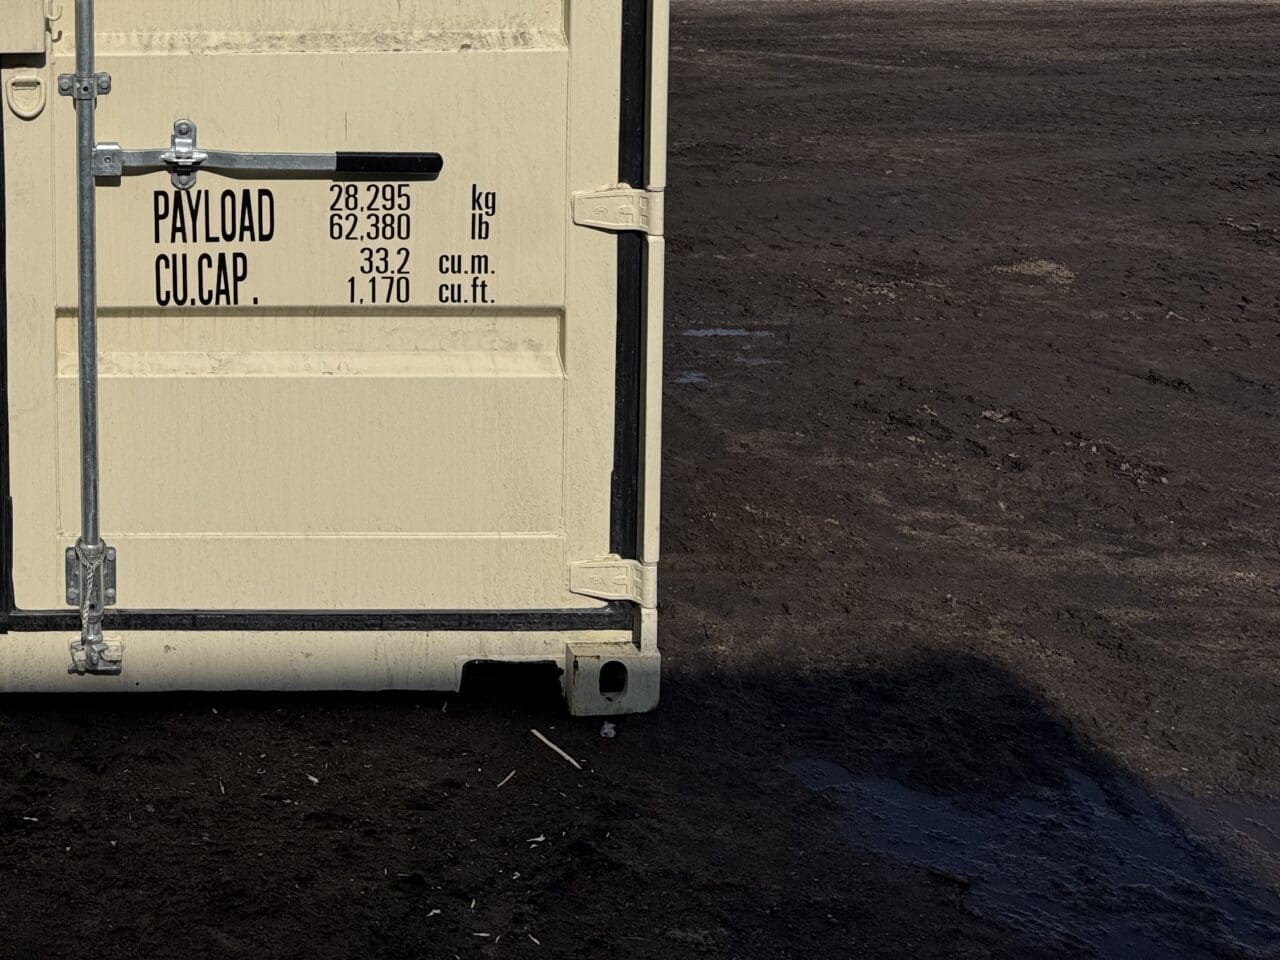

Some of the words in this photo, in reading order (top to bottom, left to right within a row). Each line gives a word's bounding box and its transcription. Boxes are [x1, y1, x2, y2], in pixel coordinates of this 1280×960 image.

[154, 189, 275, 244] PAYLOAD
[329, 184, 411, 213] 28,295
[471, 184, 496, 216] kg
[329, 213, 411, 242] 62,380
[471, 213, 490, 240] lb
[359, 247, 410, 274] 33.2
[438, 253, 496, 274] cu.m.
[348, 276, 410, 305] 1,170
[438, 276, 496, 303] cu.ft.
